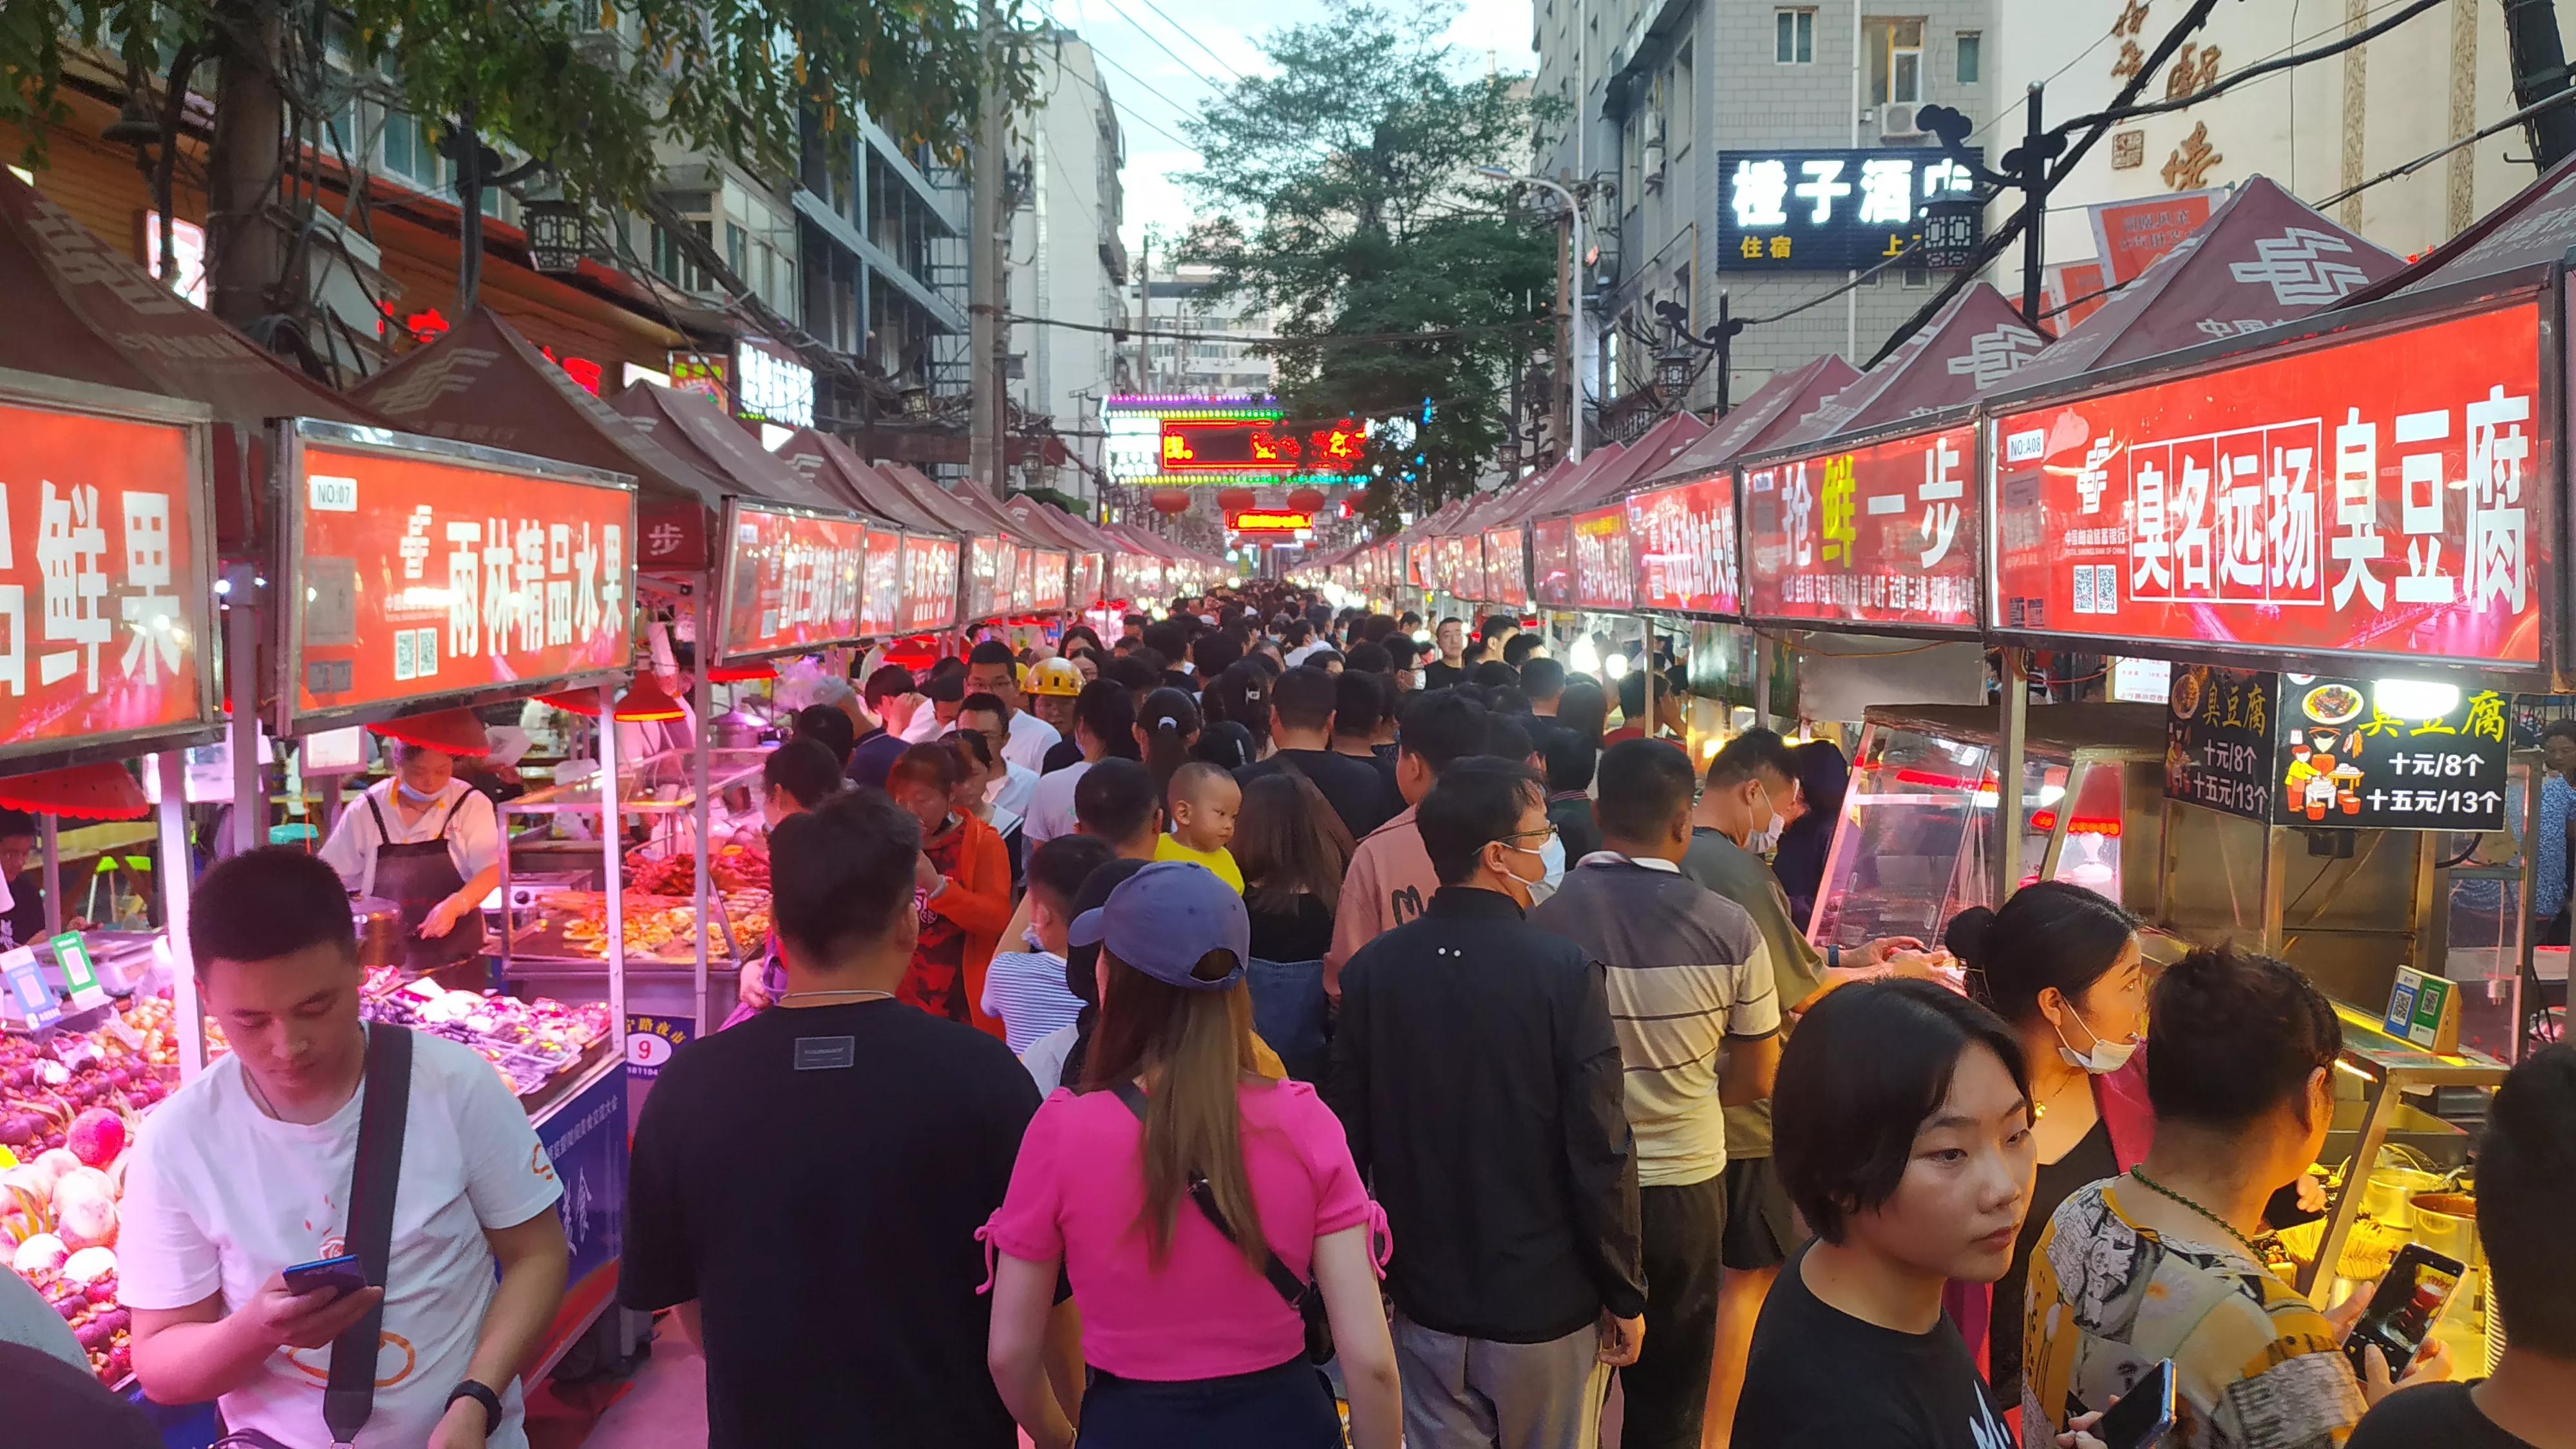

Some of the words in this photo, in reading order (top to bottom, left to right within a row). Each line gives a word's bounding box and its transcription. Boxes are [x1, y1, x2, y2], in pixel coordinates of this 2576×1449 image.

[1740, 236, 1792, 258] 住宿
[2196, 319, 2288, 337] 中国
[2010, 436, 2041, 457] NO:A08
[317, 484, 350, 504] NO:07
[1781, 438, 1964, 569] 抢鲜一步
[2134, 446, 2315, 591] 臭名远扬
[2331, 385, 2530, 614] 臭豆腐
[649, 523, 684, 555] 步
[447, 517, 622, 658] 雨林精品水果
[2202, 681, 2266, 737] 臭豆腐
[2204, 739, 2257, 774] 十元/8个
[2389, 752, 2485, 777] 十元/8个
[2193, 772, 2268, 814] 十五元/13个
[2367, 788, 2501, 814] 十五元/13个
[639, 1040, 650, 1060] 9
